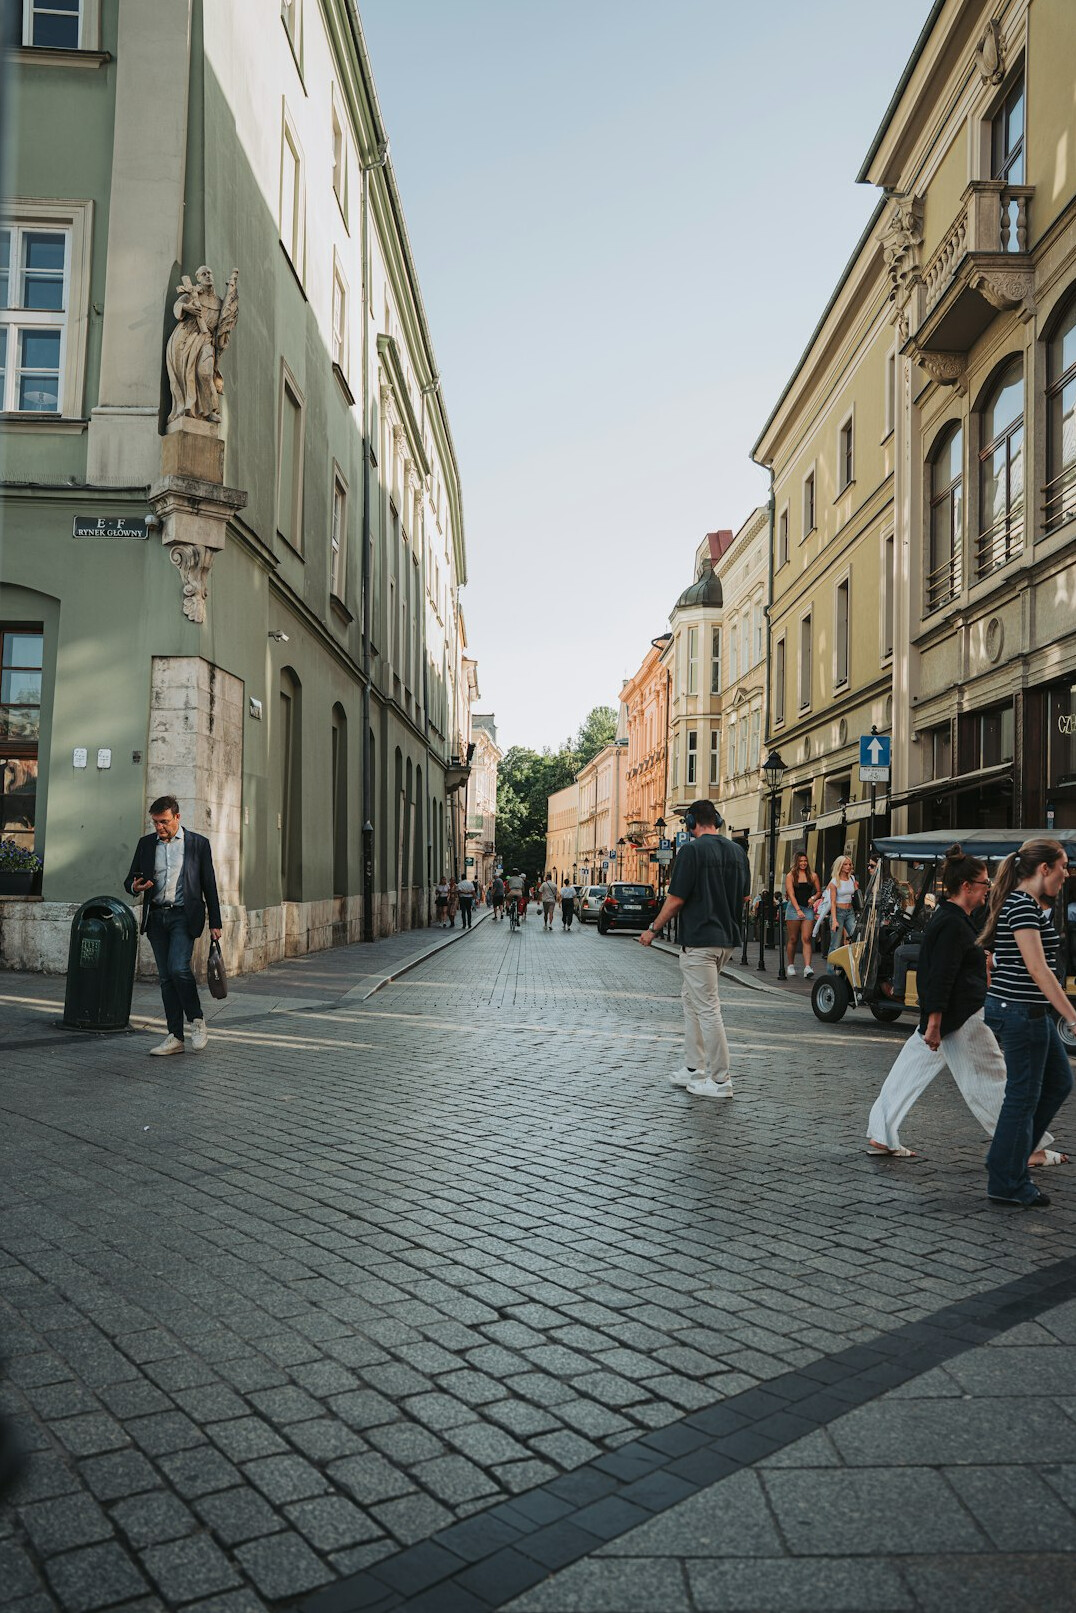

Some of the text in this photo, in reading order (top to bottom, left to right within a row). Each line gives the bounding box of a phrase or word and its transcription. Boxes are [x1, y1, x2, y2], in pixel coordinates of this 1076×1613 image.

[97, 519, 106, 528] E
[117, 519, 126, 528] F
[78, 528, 143, 537] RYNEK GŁÓWNY
[679, 833, 687, 842] P
[662, 840, 668, 850] P
